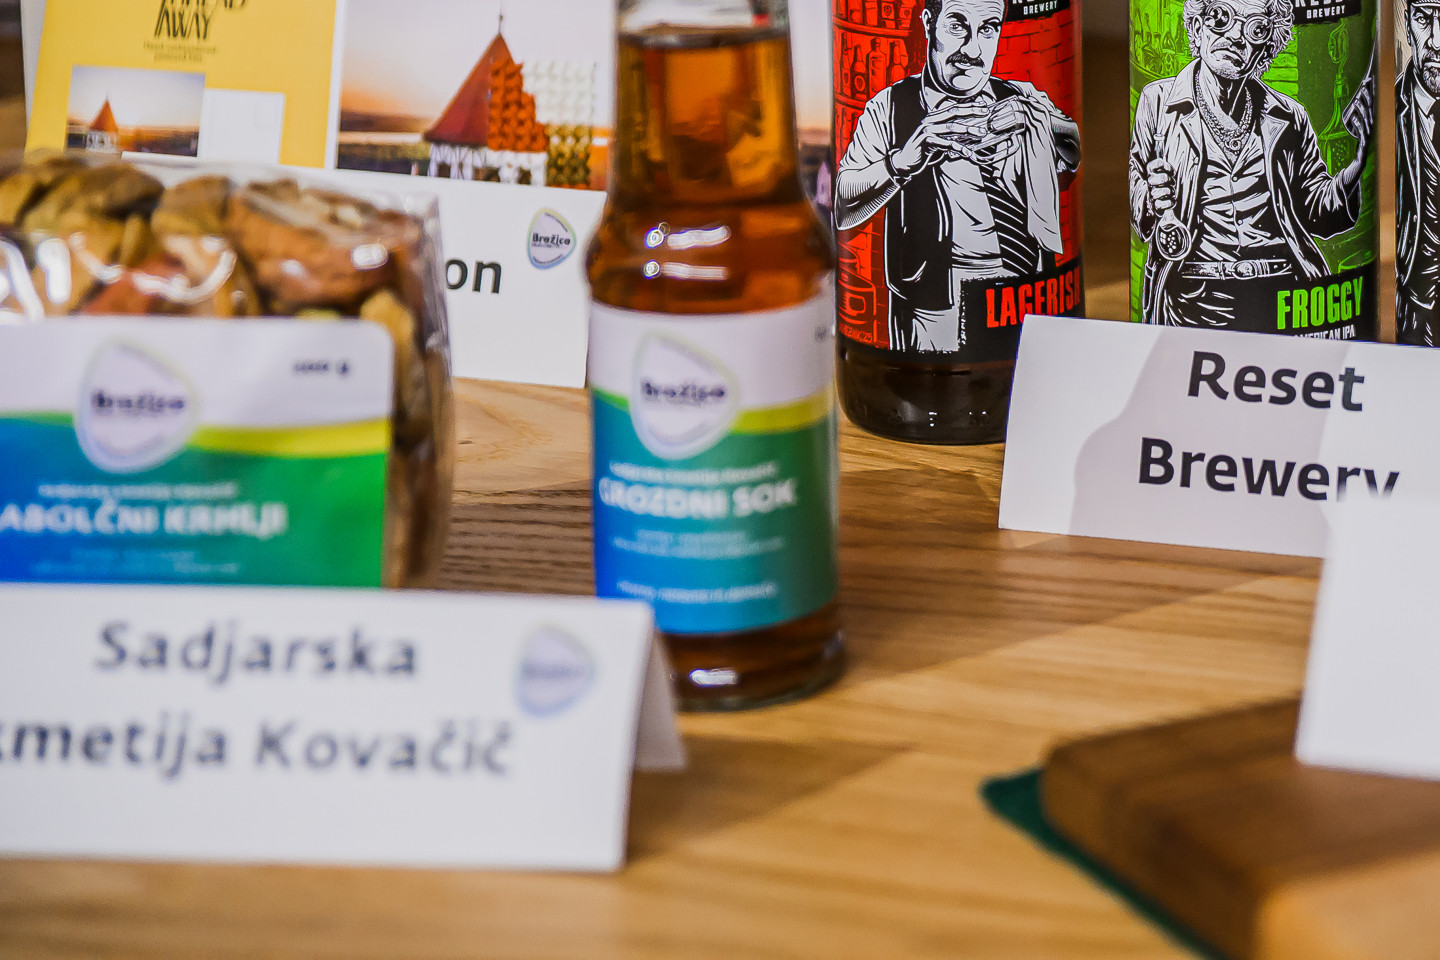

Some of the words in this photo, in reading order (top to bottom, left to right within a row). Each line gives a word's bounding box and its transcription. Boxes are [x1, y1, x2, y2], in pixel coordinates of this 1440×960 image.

[1023, 0, 1058, 15] BREWERY
[1306, 4, 1345, 19] BREWERY
[1277, 276, 1363, 330] FROGGY
[1342, 324, 1356, 340] IPA
[1187, 350, 1365, 412] Reset
[95, 619, 418, 685] Sadjarska
[0, 710, 228, 781] metija
[256, 718, 514, 775] Kovačič
